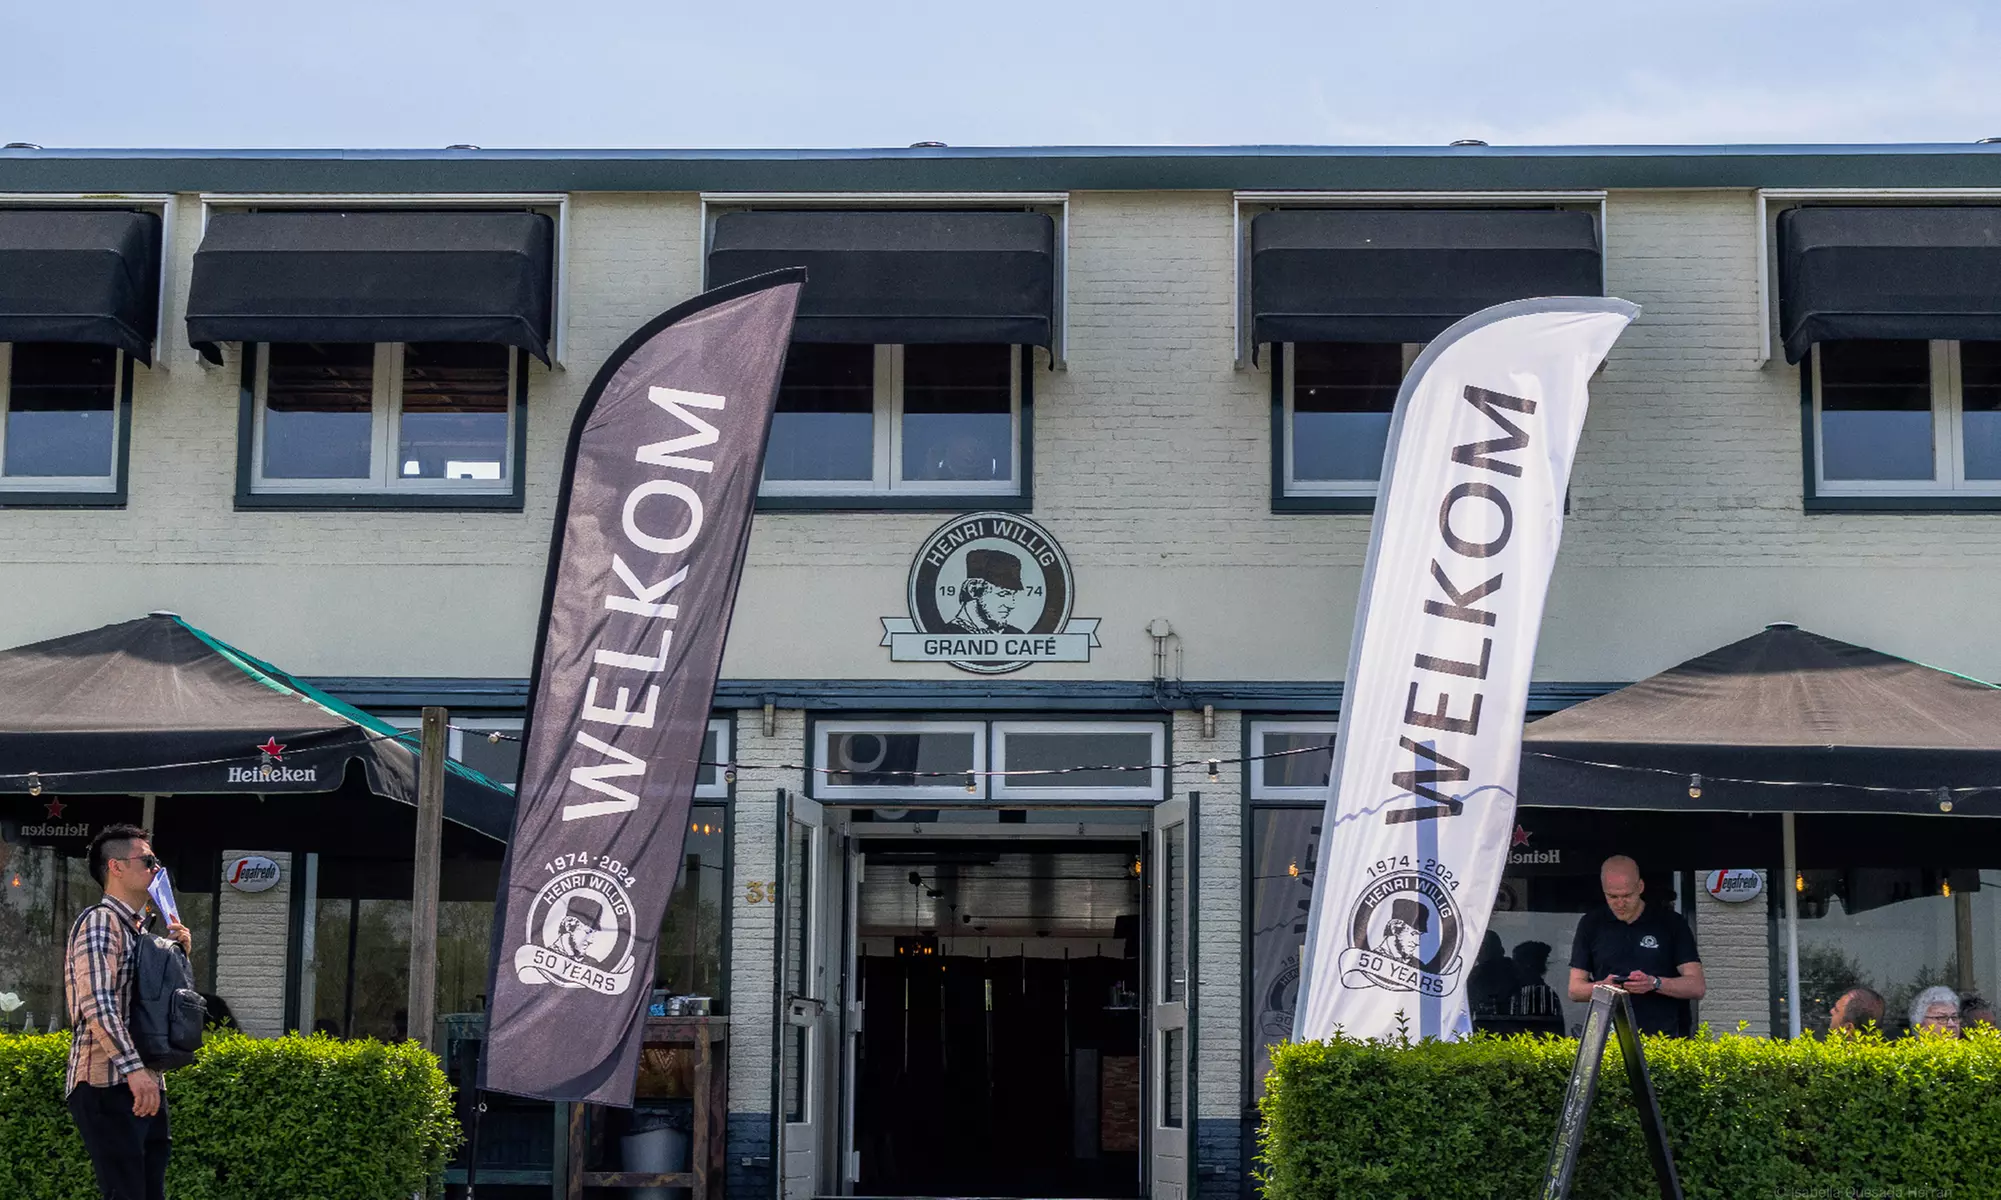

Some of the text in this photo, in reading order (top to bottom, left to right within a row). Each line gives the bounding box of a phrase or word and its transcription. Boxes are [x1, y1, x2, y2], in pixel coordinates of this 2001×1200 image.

[926, 520, 1056, 567] HENRI WILLIG
[561, 385, 726, 822] WELKOM
[939, 586, 1043, 597] 19 74
[1384, 384, 1537, 826] WELKOM
[924, 637, 1056, 656] GRAND CAFÉ
[228, 766, 317, 782] Heineken
[230, 860, 276, 883] Segafredo
[544, 851, 636, 888] 1974 2024
[1366, 855, 1460, 891] 1974 2024
[1711, 869, 1758, 893] Segafredo
[543, 875, 627, 915] HENRI WILLIG
[1364, 878, 1452, 918] HENRI WILLIG
[533, 950, 615, 991] 50 YEARS
[1359, 952, 1443, 993] 50 YEARS
